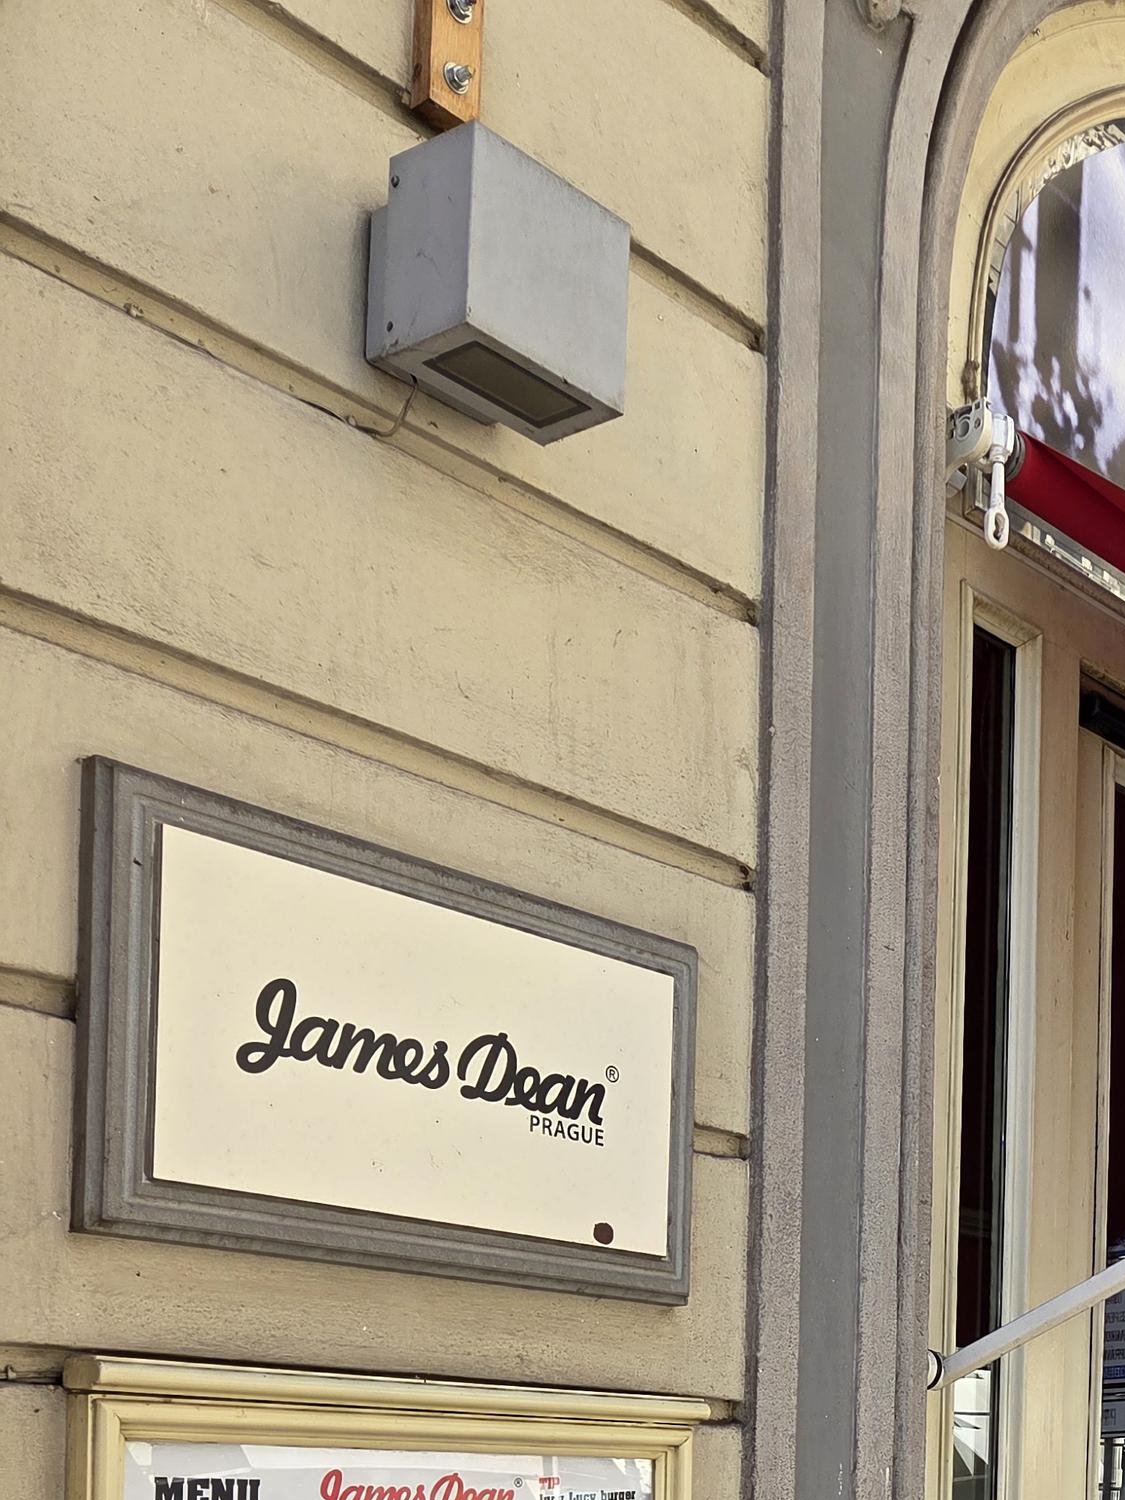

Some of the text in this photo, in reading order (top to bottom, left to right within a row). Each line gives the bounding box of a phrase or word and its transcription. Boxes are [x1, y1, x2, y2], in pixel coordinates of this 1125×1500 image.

[235, 978, 606, 1126] James Dean
[528, 1115, 605, 1147] PRAGUE
